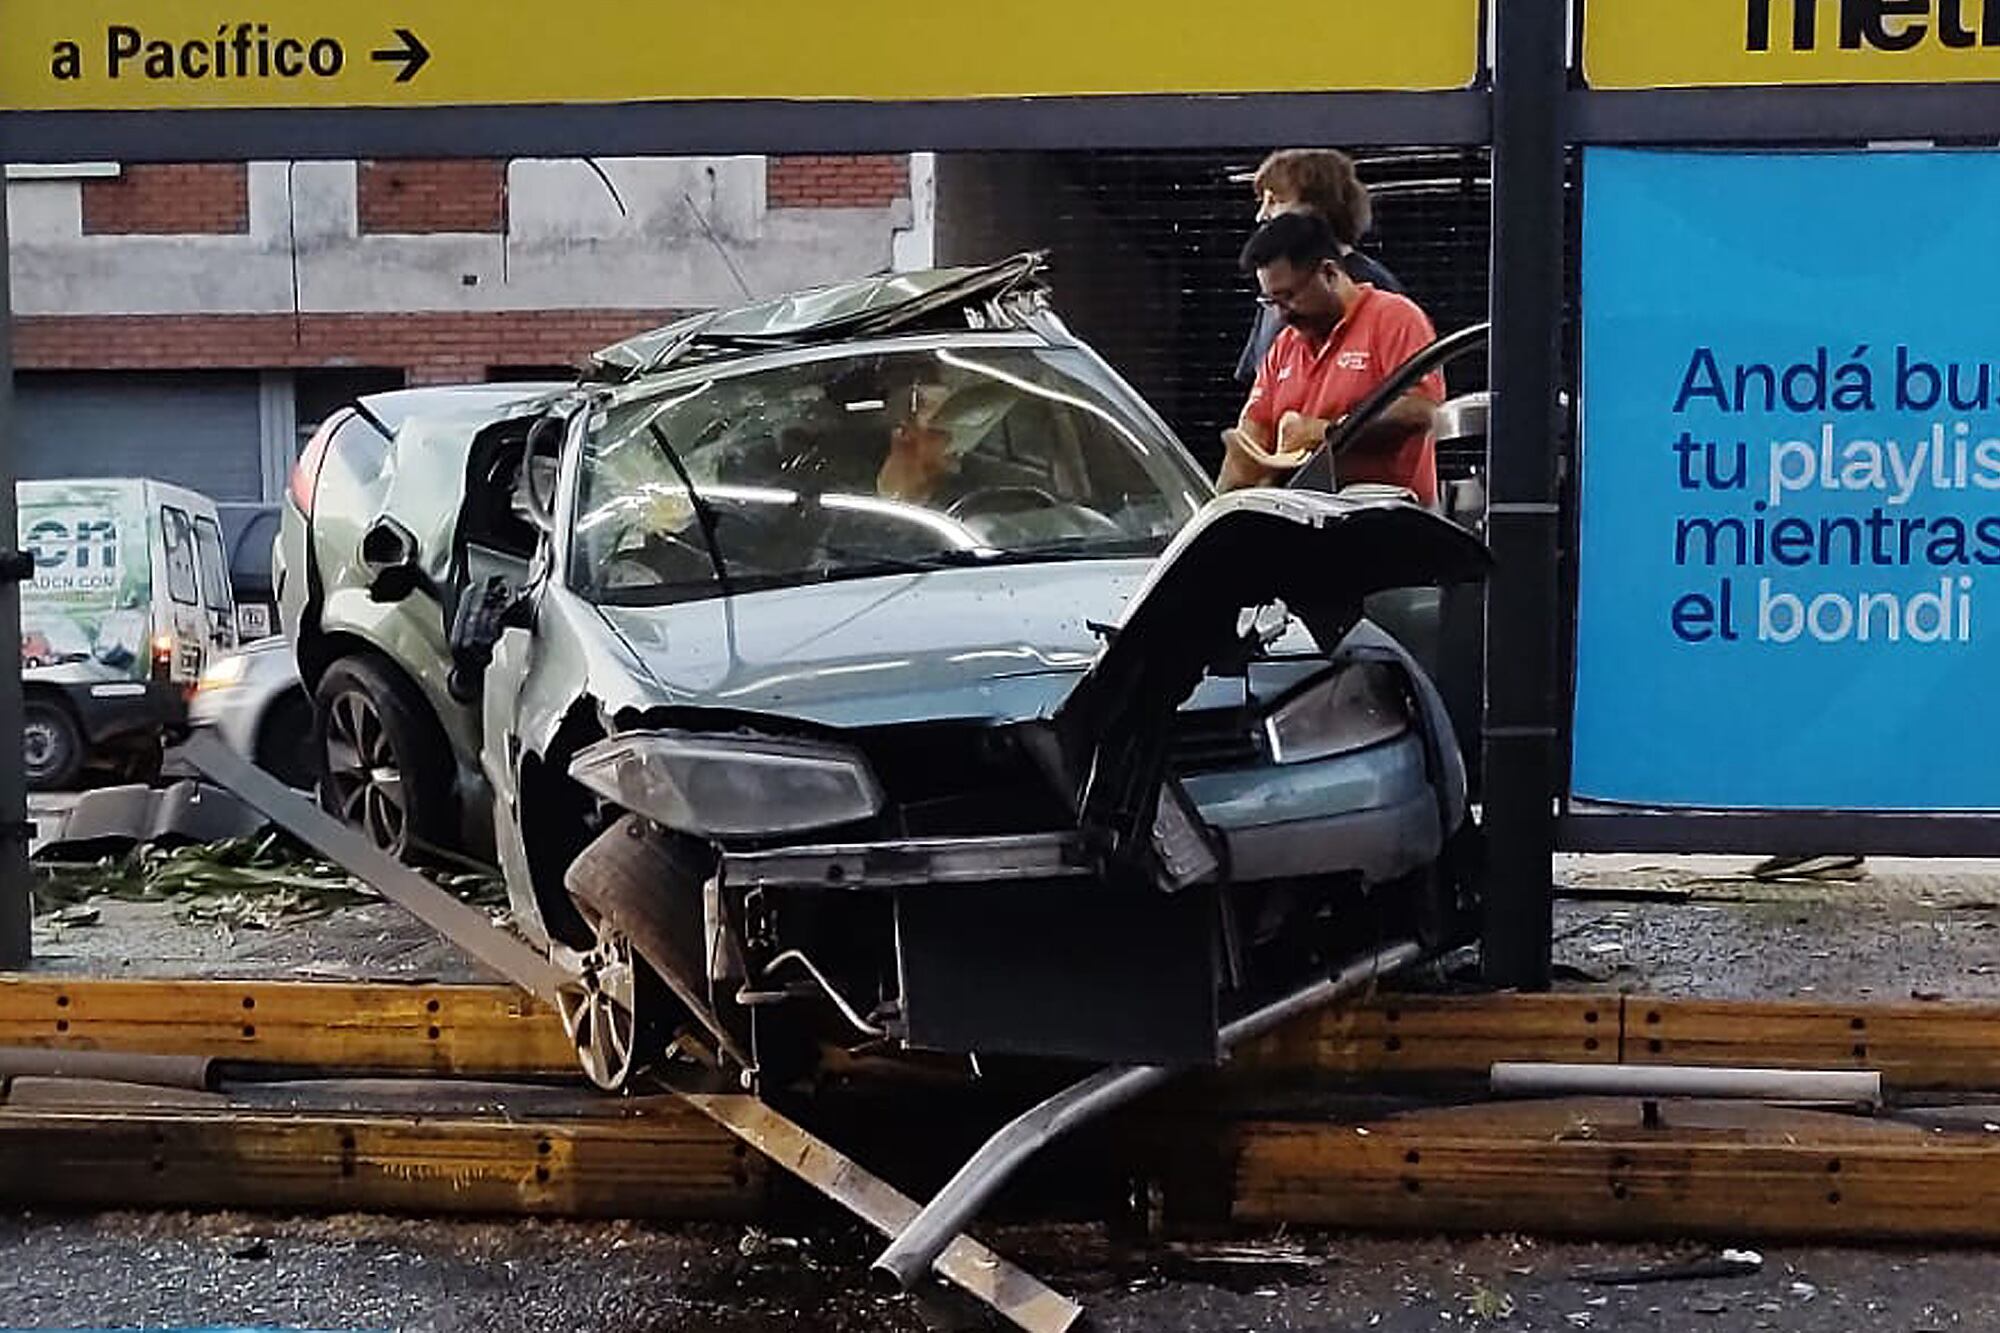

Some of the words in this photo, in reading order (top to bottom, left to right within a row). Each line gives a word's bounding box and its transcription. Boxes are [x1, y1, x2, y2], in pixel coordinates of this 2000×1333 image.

[51, 41, 81, 80] a
[107, 23, 344, 79] Pacífico
[1672, 345, 1876, 413] Andá
[1895, 346, 2000, 412] bu
[1672, 432, 1747, 490] tu
[1674, 500, 2000, 567] mientras
[1671, 577, 1739, 643] el
[1758, 576, 1972, 642] bondi
